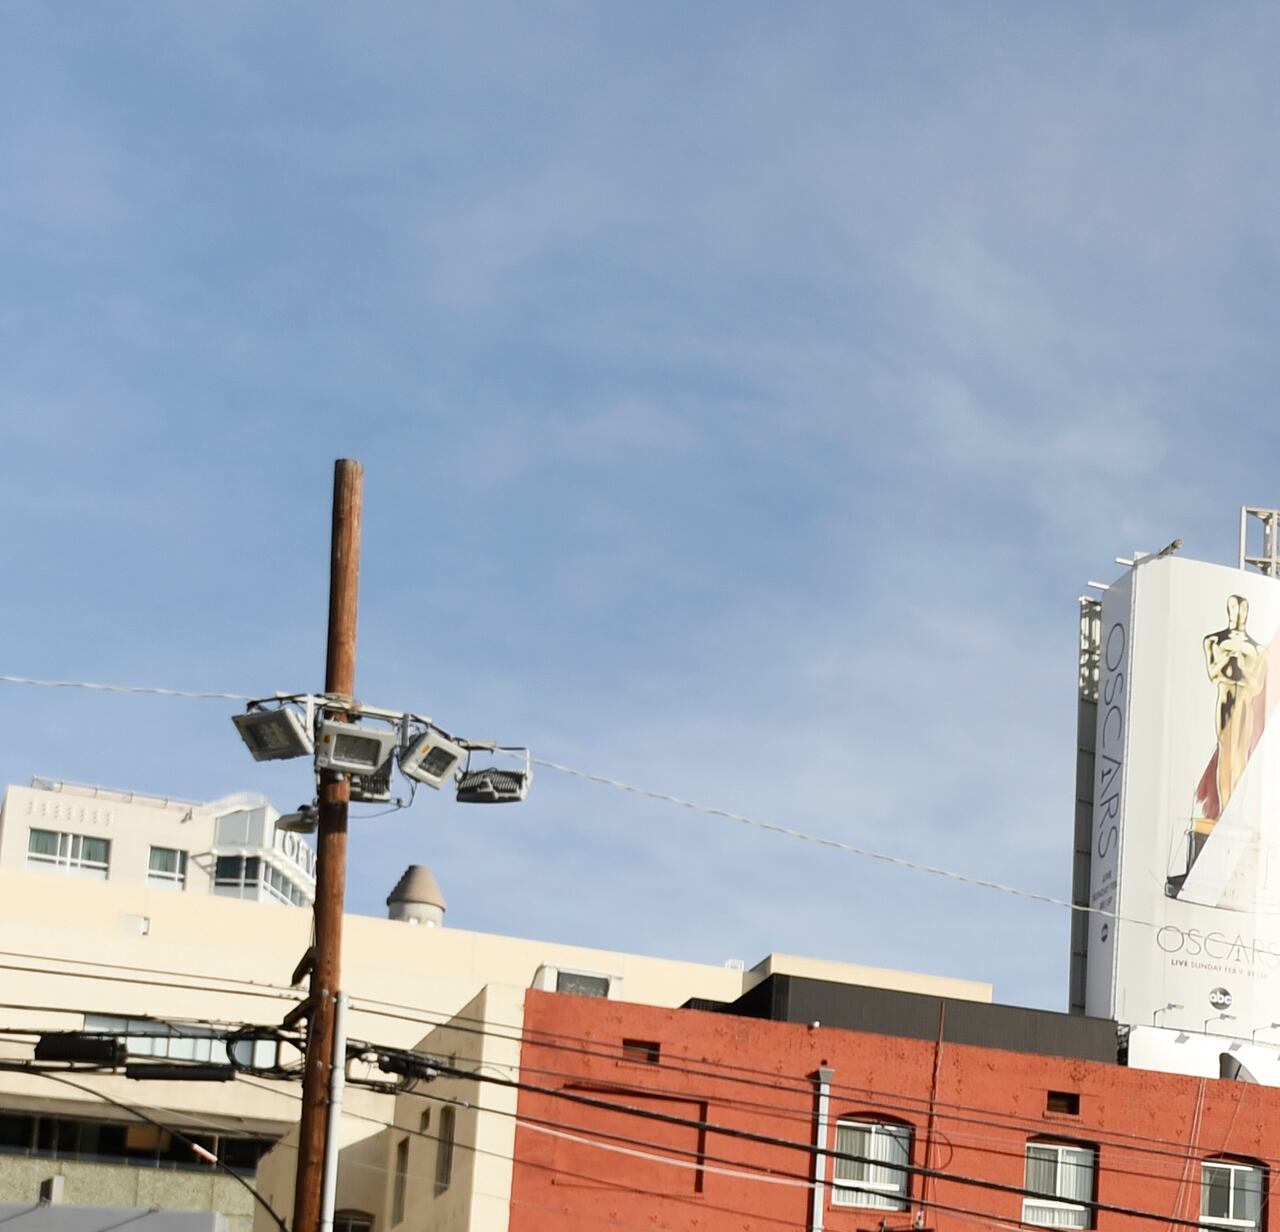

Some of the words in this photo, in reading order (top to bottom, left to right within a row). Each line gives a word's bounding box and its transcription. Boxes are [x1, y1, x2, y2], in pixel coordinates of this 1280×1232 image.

[1098, 622, 1125, 858] OSCARS
[1156, 925, 1280, 969] OSCARS
[1170, 959, 1188, 967] LIVE
[1191, 961, 1222, 972] SUNDAY
[1224, 966, 1236, 975] FEB
[1209, 989, 1231, 1005] abc
